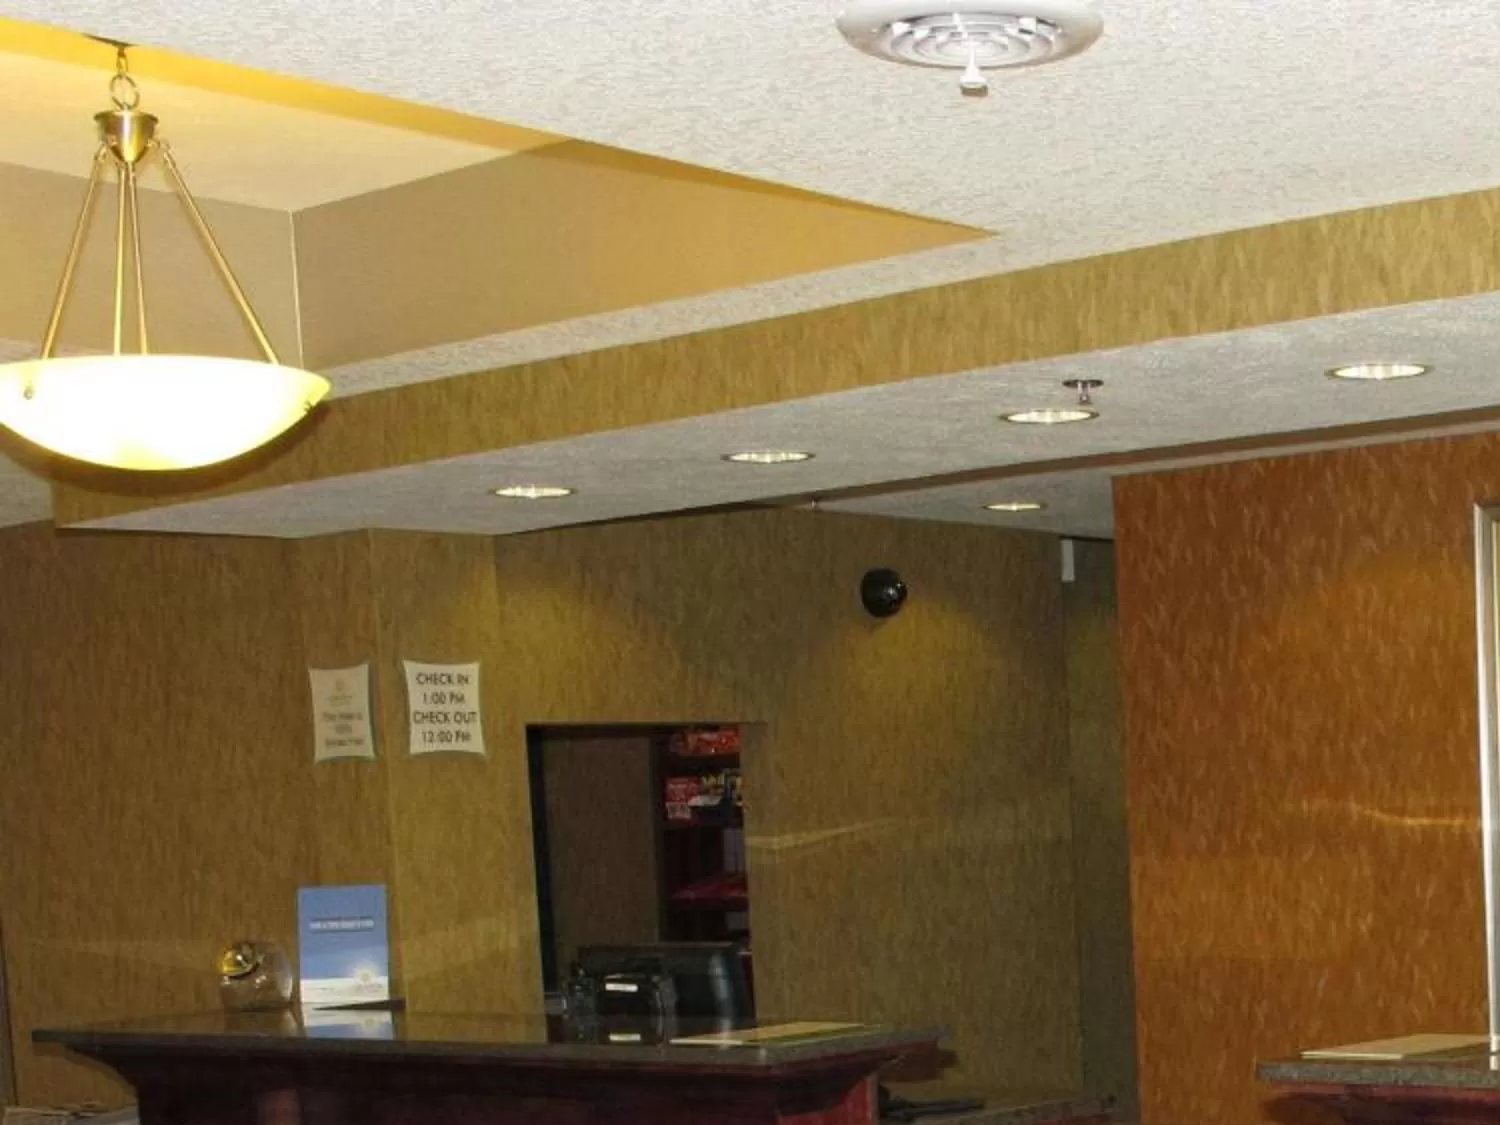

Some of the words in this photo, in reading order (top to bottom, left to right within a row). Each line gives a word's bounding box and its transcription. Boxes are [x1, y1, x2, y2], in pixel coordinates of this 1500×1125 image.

[416, 672, 453, 684] CHECK
[457, 673, 469, 684] IN
[449, 692, 465, 704] PM
[413, 711, 450, 724] CHECK
[453, 711, 477, 724] OUT
[455, 730, 471, 742] PM
